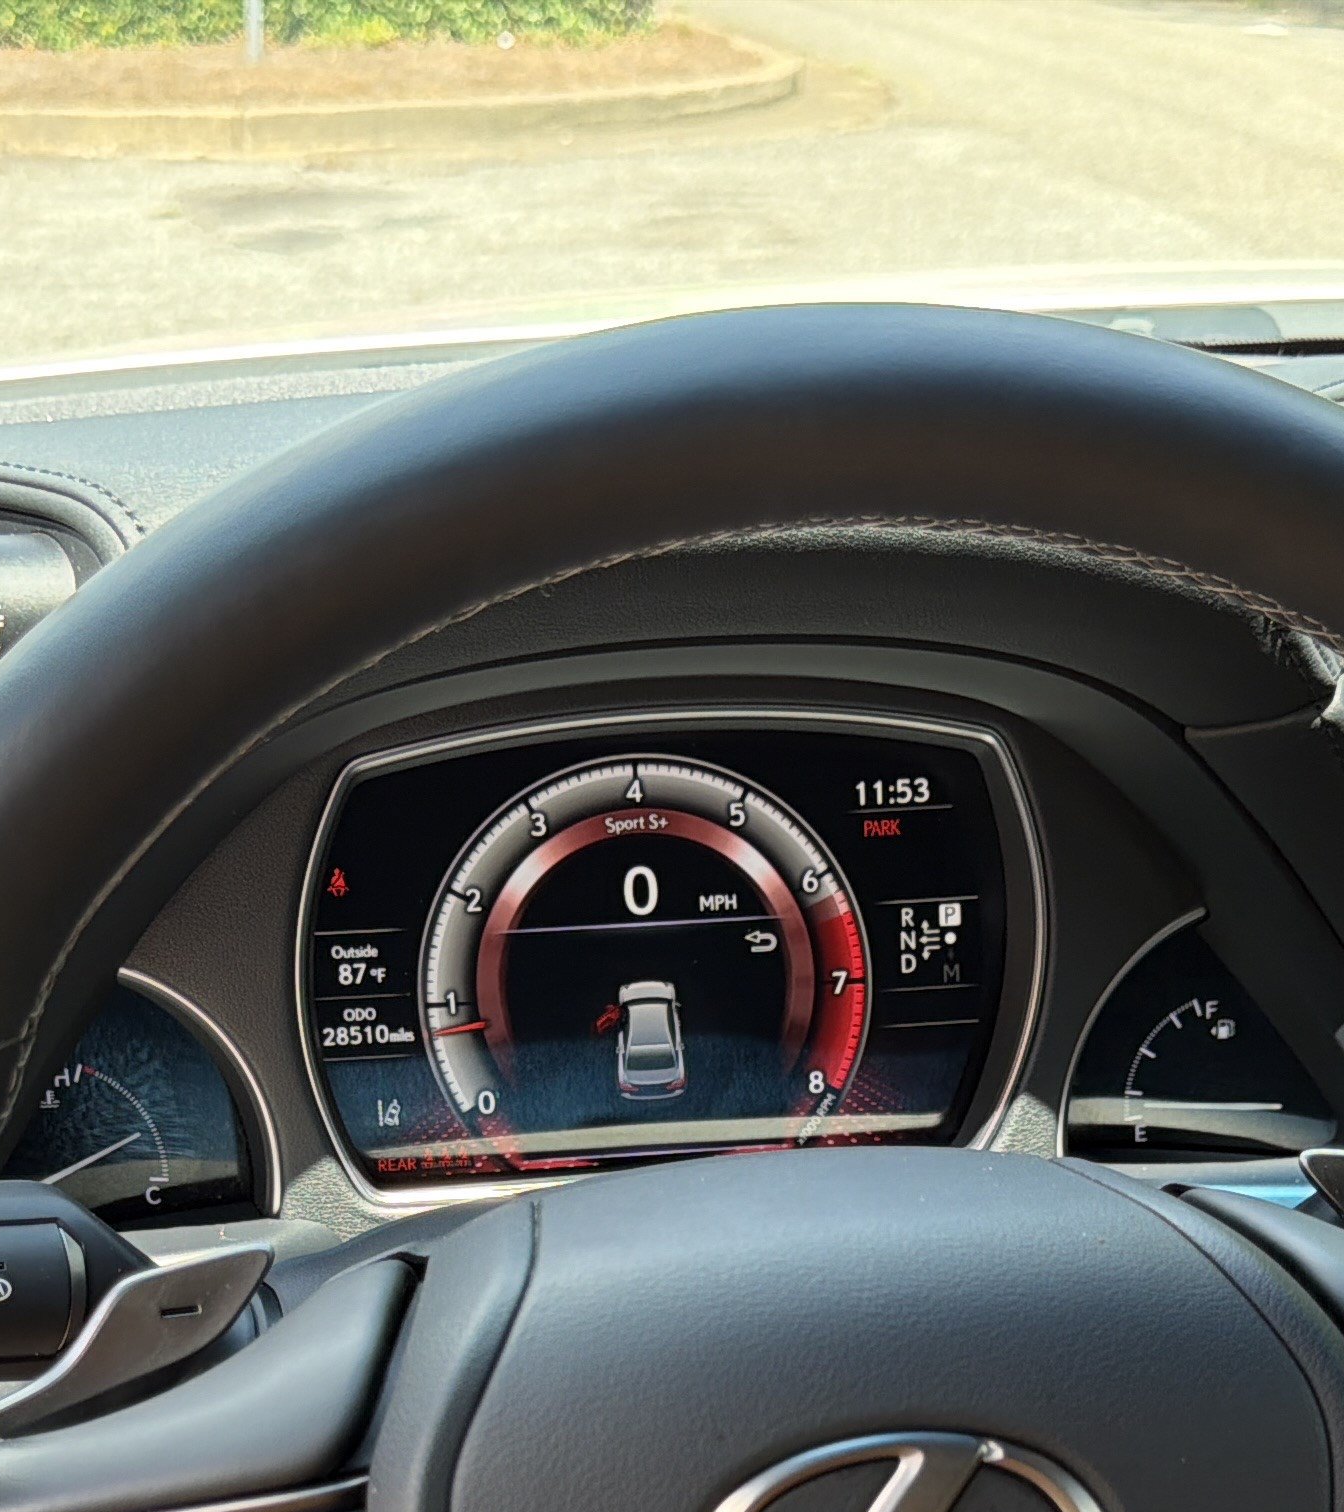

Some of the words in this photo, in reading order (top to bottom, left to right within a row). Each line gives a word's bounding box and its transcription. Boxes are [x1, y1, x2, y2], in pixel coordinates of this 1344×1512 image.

[626, 779, 644, 802] 4
[855, 777, 930, 806] 11:53
[530, 812, 549, 838] 3
[604, 814, 646, 835] Sport
[647, 811, 670, 831] S+
[728, 803, 747, 828] 5
[863, 819, 901, 838] PARK
[622, 865, 658, 916] 0
[801, 870, 819, 894] 6
[464, 888, 483, 913] 2
[698, 893, 738, 912] MPH
[901, 907, 916, 928] R
[330, 943, 379, 960] Outside
[899, 930, 917, 951] N
[338, 963, 367, 986] 87
[901, 953, 917, 974] D
[942, 962, 961, 984] M
[831, 971, 848, 995] 7
[342, 1007, 377, 1022] ODO
[445, 991, 457, 1016] 1
[1204, 999, 1219, 1018] F
[322, 1024, 389, 1047] 28510
[808, 1070, 825, 1094] 8
[477, 1090, 496, 1115] 0
[1134, 1125, 1148, 1143] E
[377, 1157, 417, 1172] REAR
[145, 1186, 162, 1205] C
